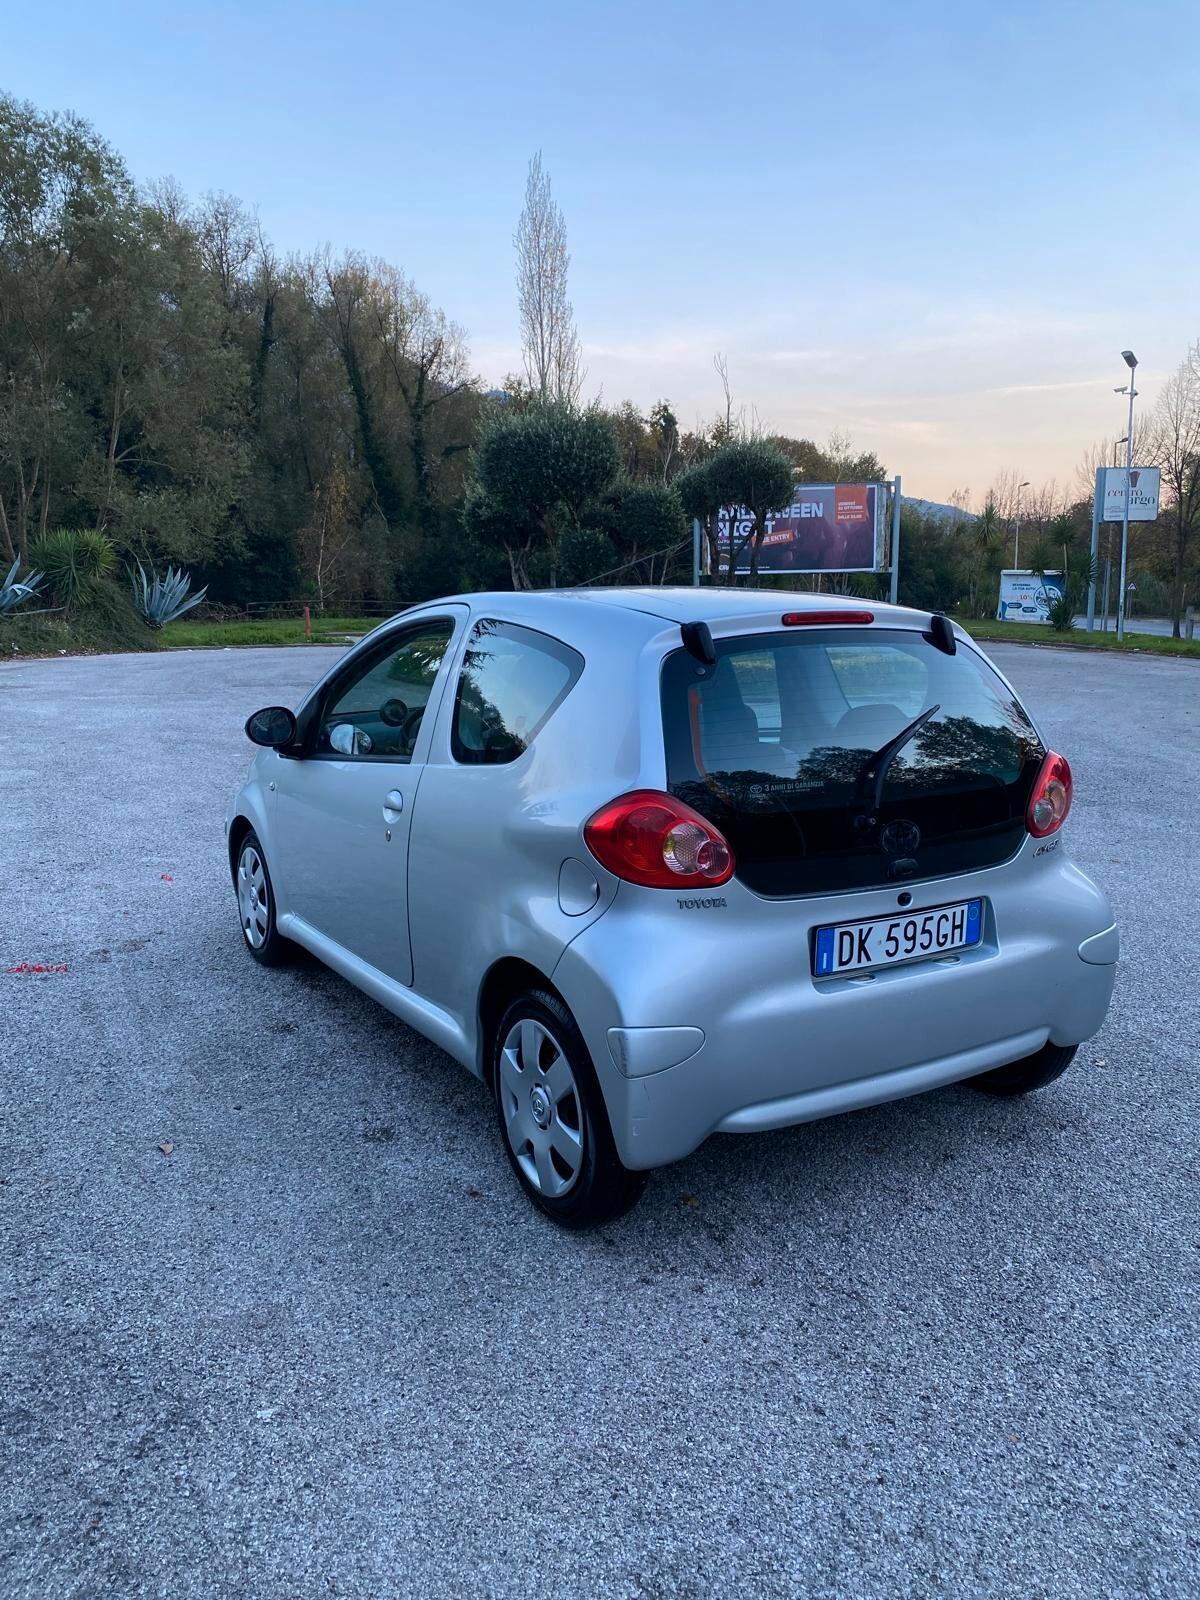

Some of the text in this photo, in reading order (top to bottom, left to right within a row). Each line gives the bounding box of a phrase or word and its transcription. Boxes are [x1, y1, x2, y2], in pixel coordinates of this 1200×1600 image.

[1108, 489, 1143, 497] cenro
[718, 520, 776, 537] NIGT
[770, 533, 790, 542] ENTRY
[764, 784, 770, 792] 3
[770, 783, 786, 792] ANNI
[787, 782, 794, 790] DI
[795, 780, 825, 789] GARANZIA
[677, 896, 728, 909] TOYOTA
[838, 926, 874, 967] DK
[885, 909, 965, 958] 595GH
